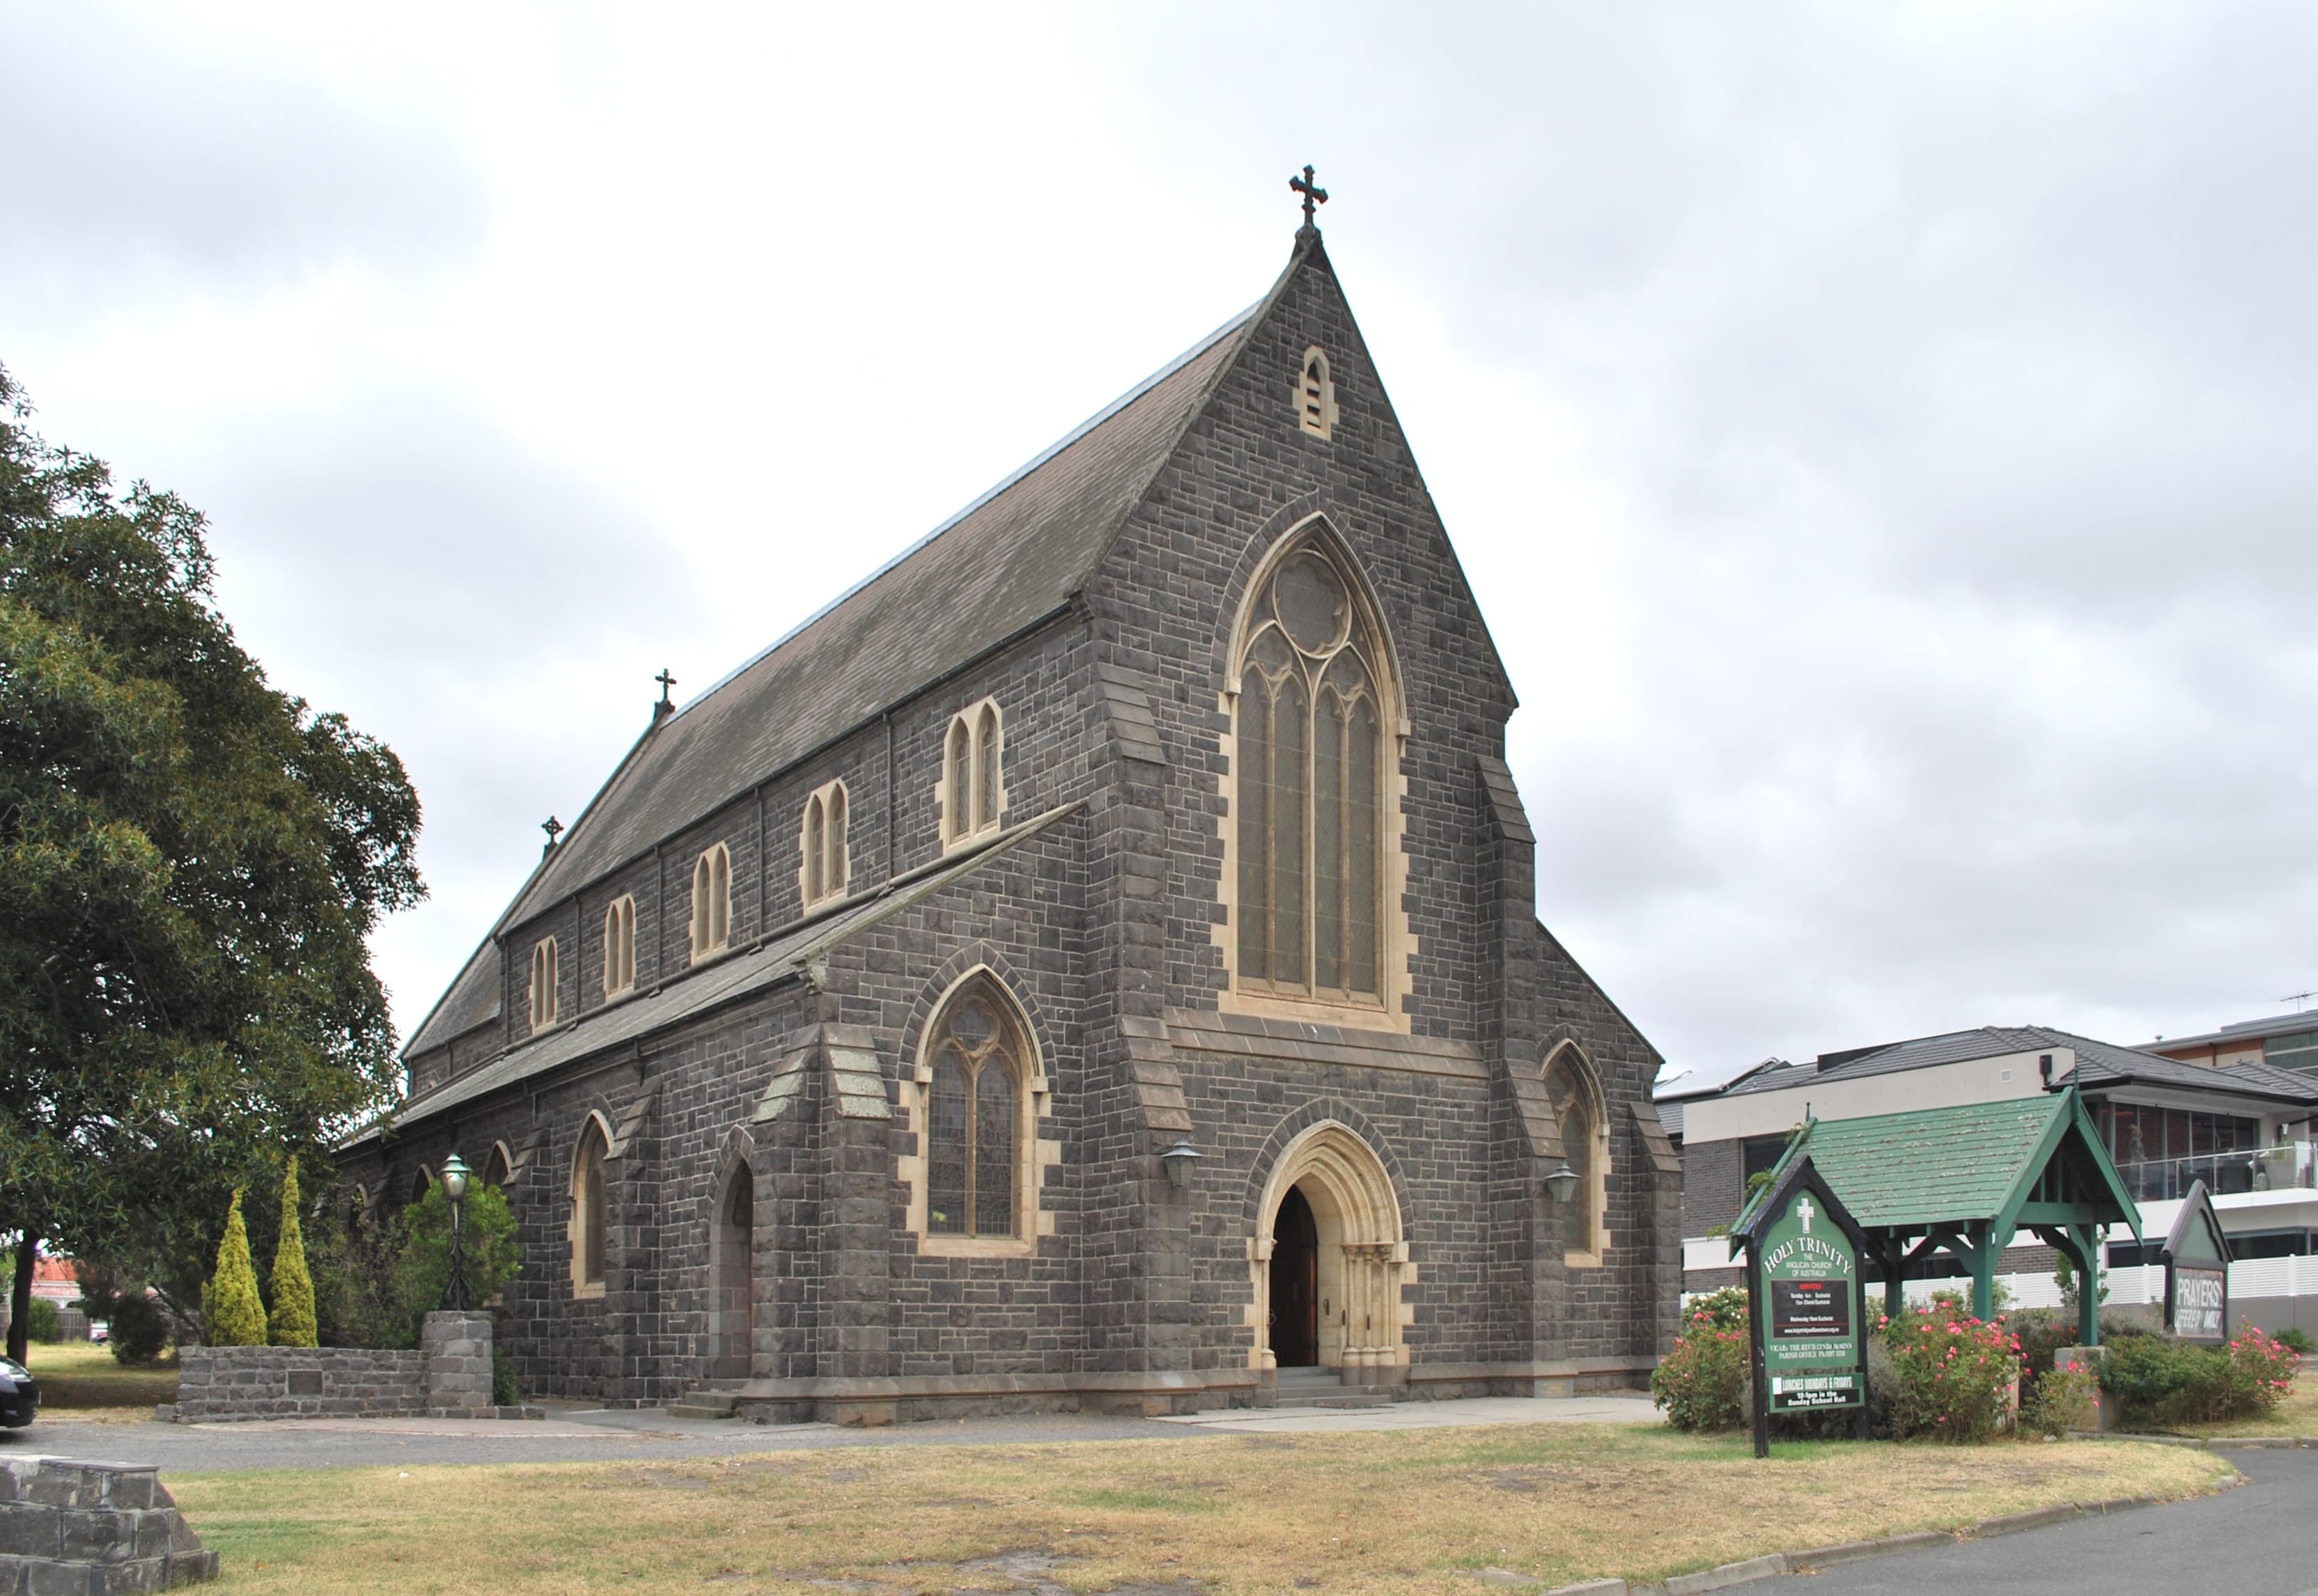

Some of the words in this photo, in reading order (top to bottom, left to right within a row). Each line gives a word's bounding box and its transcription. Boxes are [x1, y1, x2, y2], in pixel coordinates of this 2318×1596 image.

[1764, 1239, 1794, 1274] HOLY
[1797, 1237, 1851, 1275] TRINITY
[2177, 1278, 2219, 1307] PRAYERS
[1782, 1379, 1804, 1391] LUNCHES
[1833, 1376, 1852, 1388] FRIDAYS
